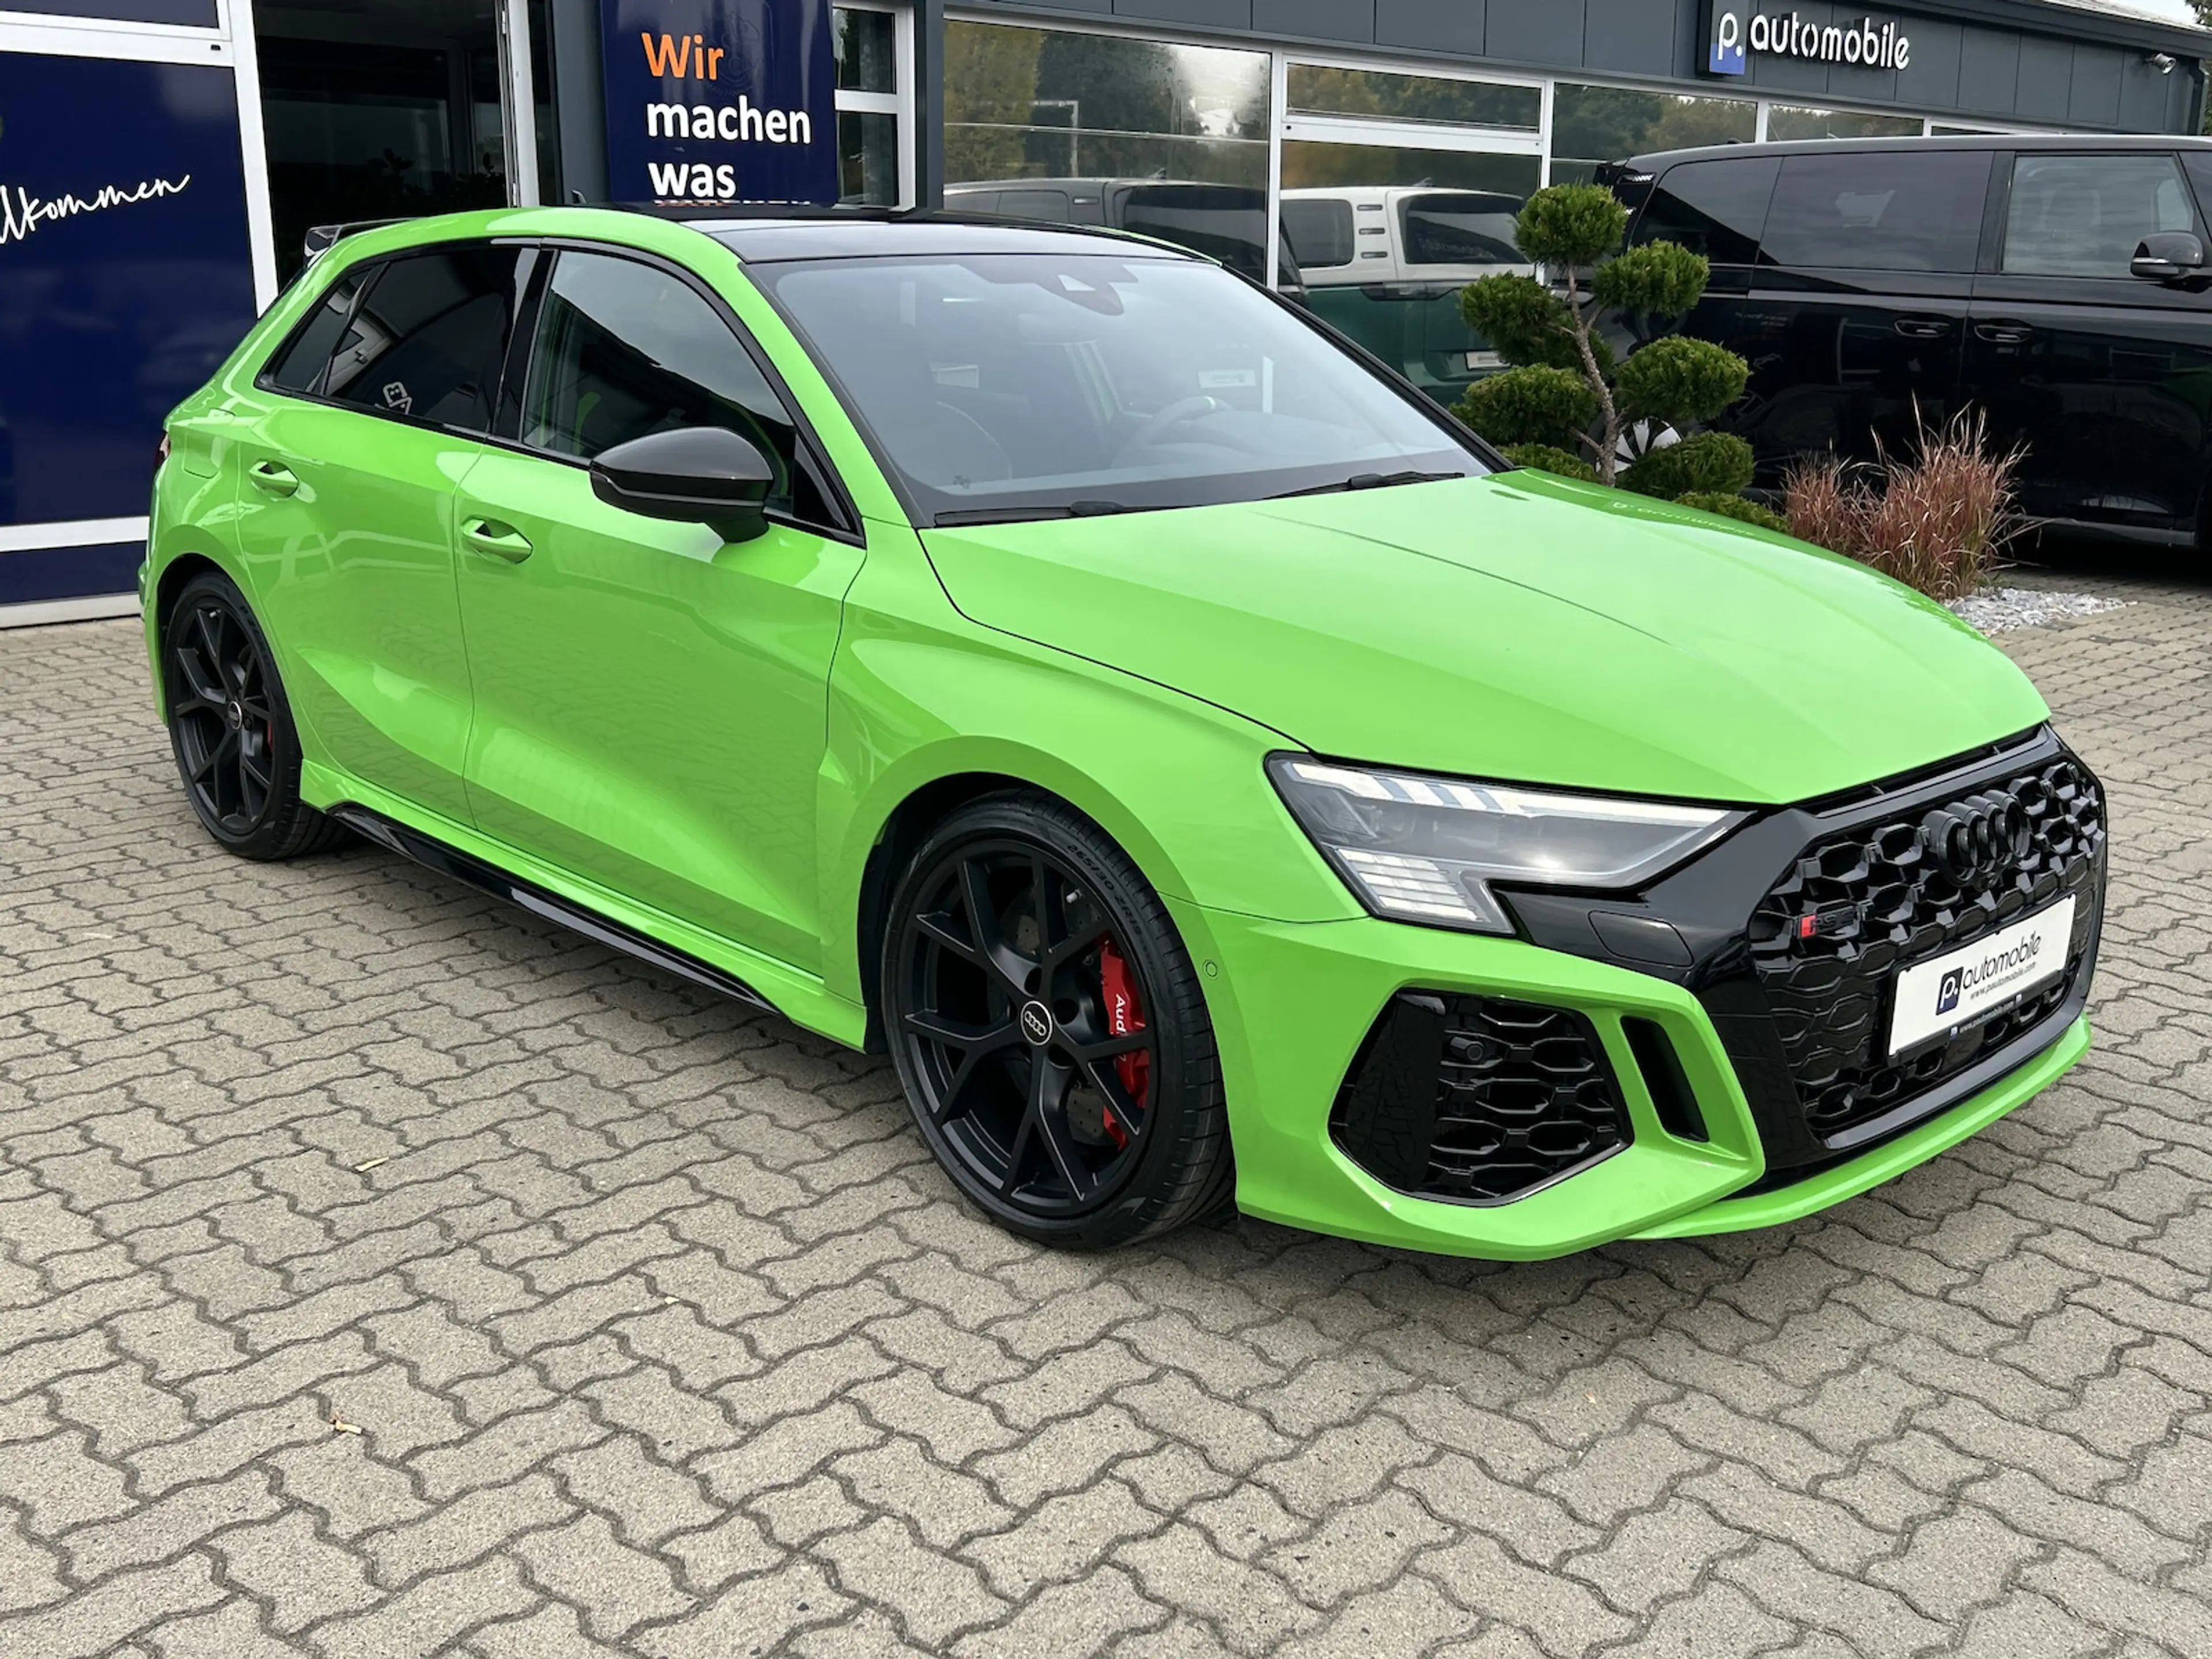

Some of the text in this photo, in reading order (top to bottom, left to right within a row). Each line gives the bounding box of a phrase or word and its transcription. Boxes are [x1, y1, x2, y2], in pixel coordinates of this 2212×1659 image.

[641, 32, 724, 81] Wir
[1750, 12, 1910, 70] automobile
[646, 94, 811, 145] machen
[648, 162, 737, 199] was
[0, 174, 191, 244] lkommen
[1963, 930, 2041, 990] automobile
